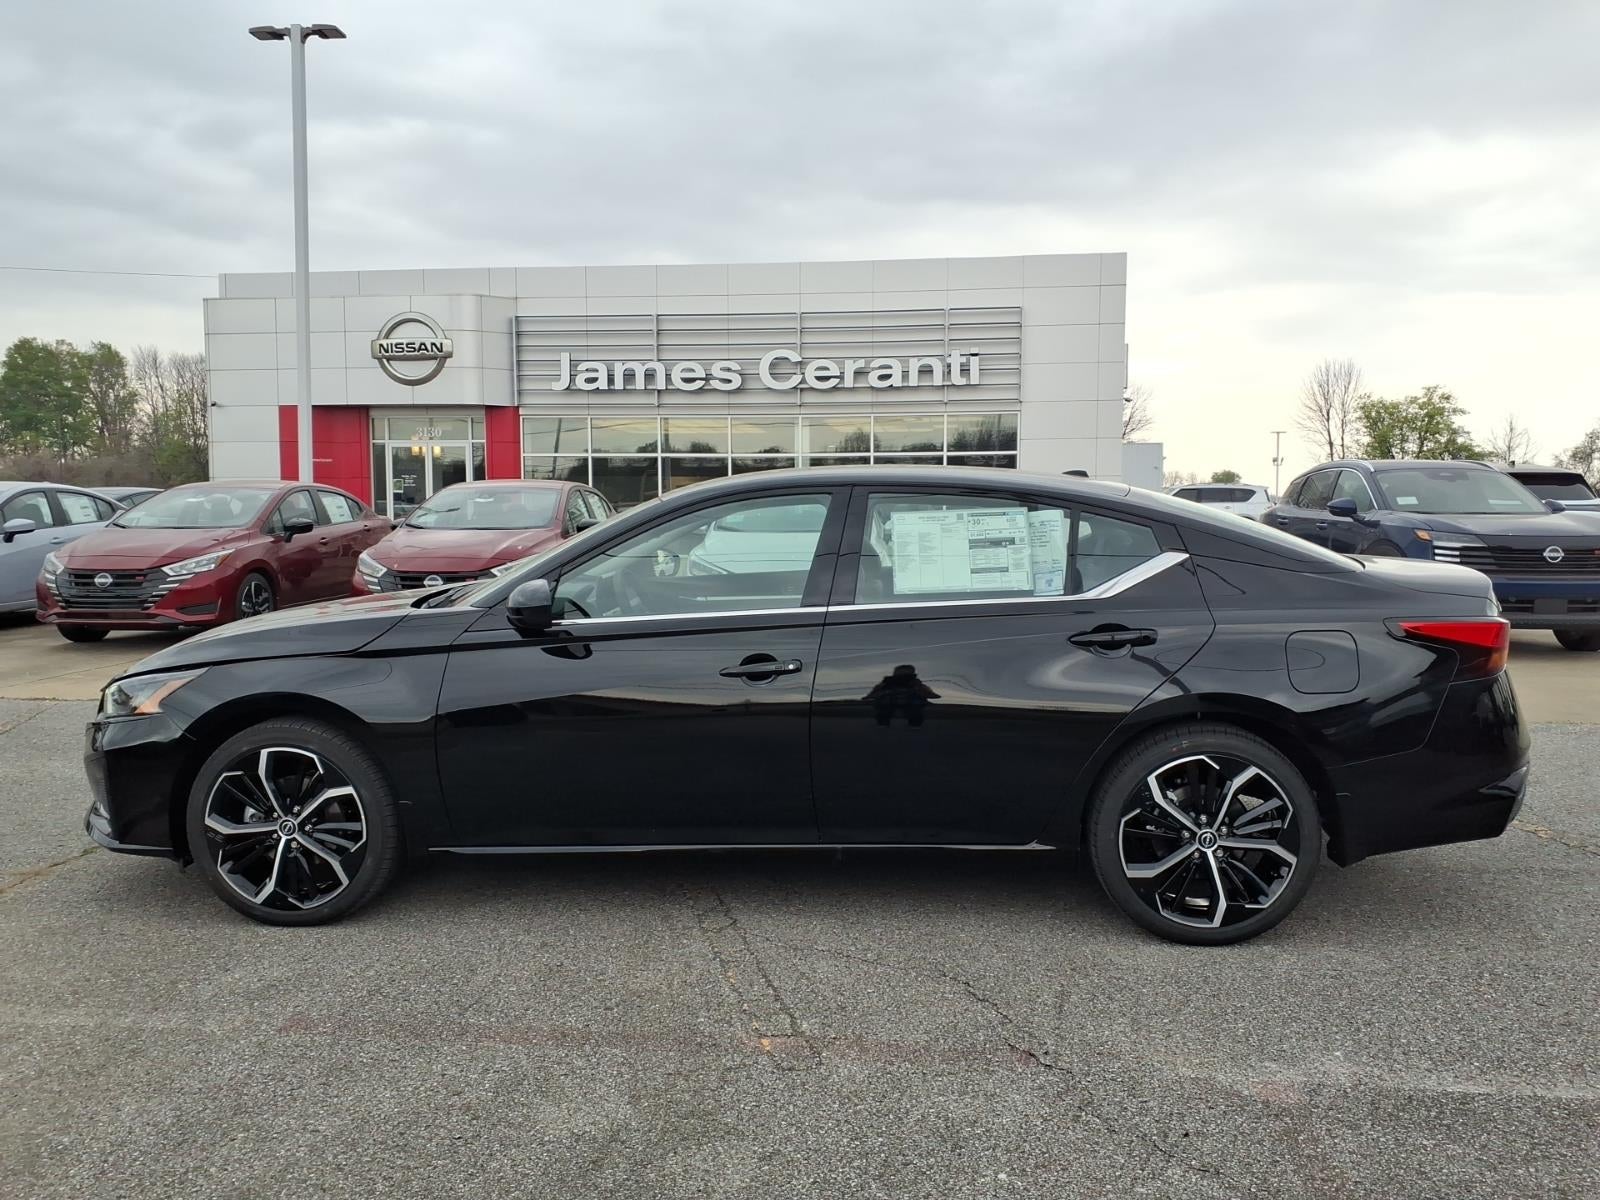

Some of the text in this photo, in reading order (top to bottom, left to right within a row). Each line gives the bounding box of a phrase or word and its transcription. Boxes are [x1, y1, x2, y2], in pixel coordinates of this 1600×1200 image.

[378, 342, 444, 354] NISSAN
[551, 347, 980, 391] James Ceranti
[416, 426, 442, 437] 3130
